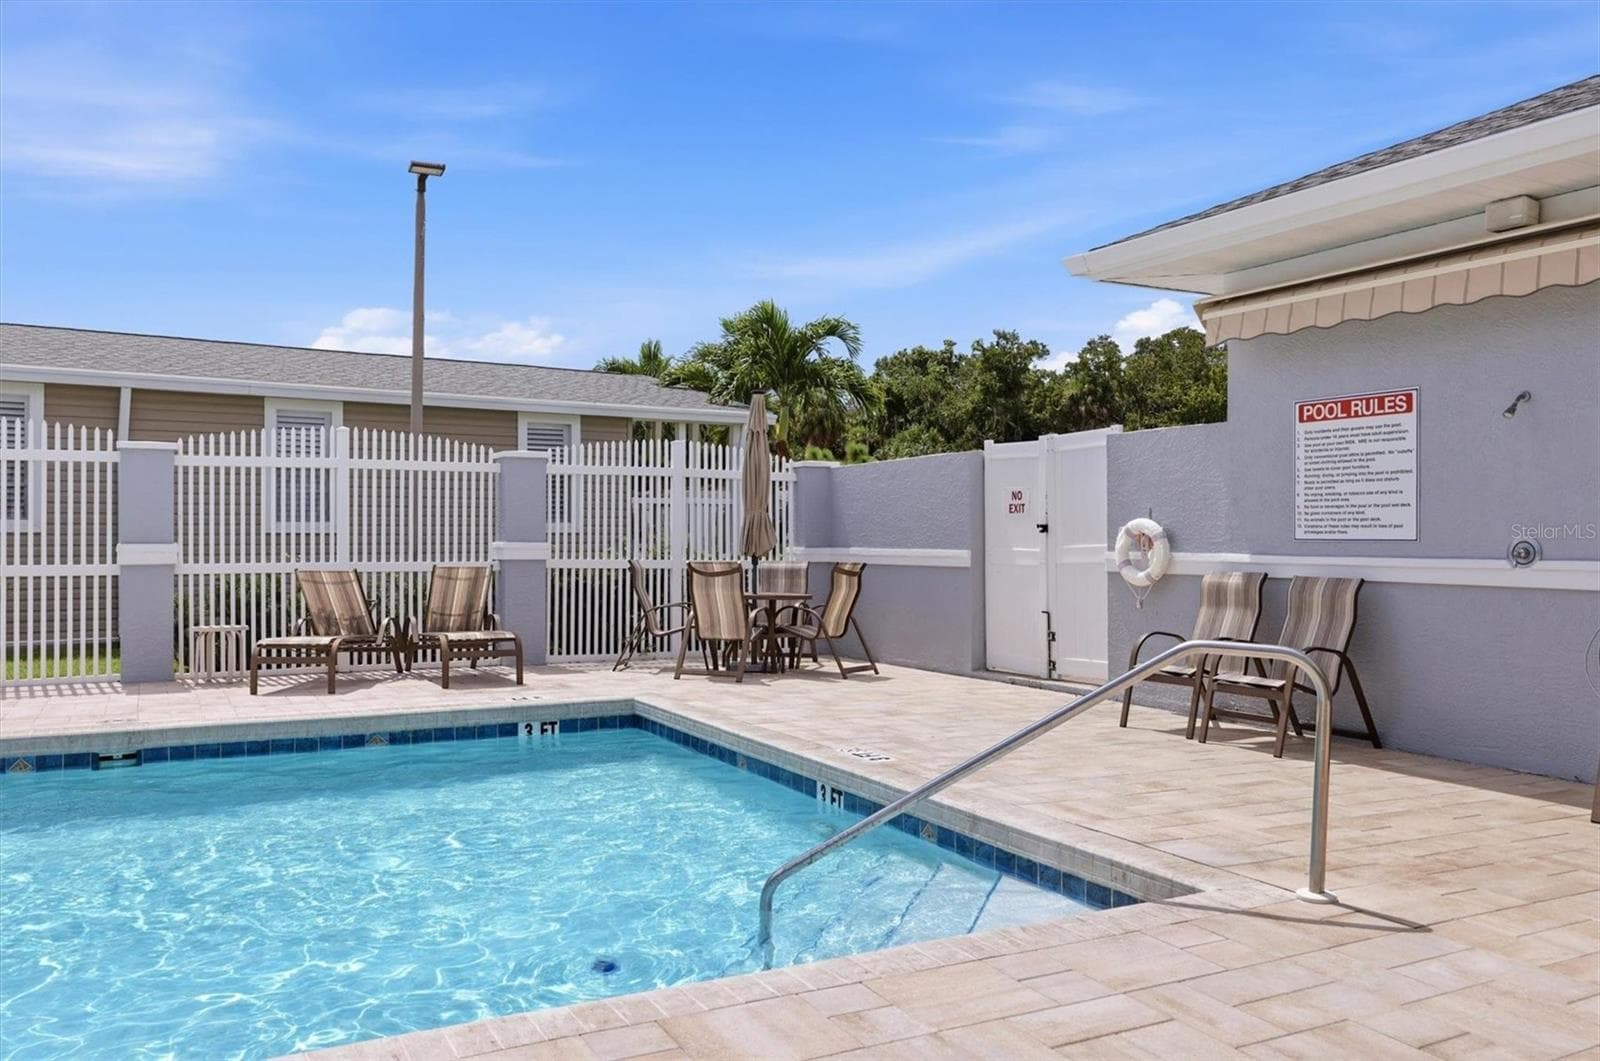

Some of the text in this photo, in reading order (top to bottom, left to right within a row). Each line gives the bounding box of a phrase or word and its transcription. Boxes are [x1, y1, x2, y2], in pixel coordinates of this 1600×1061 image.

[1303, 396, 1406, 420] POOL RULES
[1011, 490, 1023, 501] NO
[1009, 503, 1025, 514] EXIT
[540, 721, 558, 736] FT
[831, 787, 843, 809] FT
